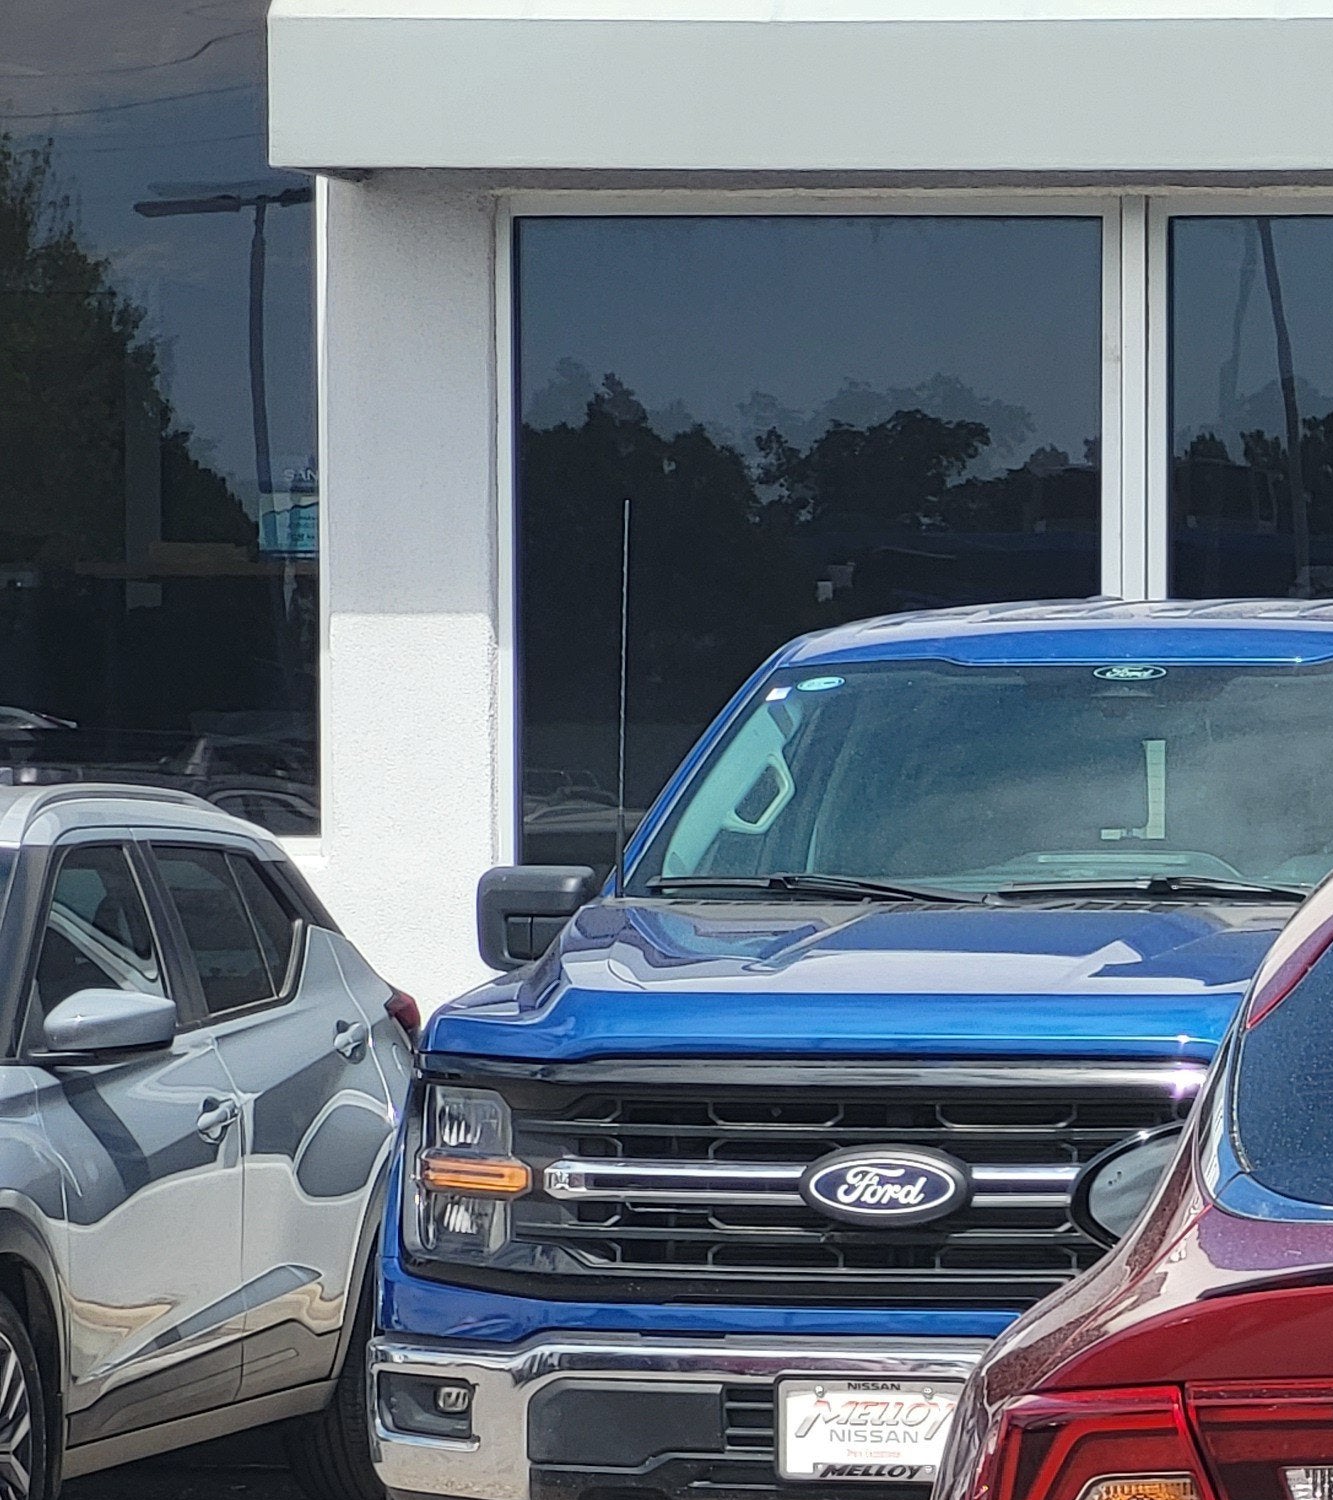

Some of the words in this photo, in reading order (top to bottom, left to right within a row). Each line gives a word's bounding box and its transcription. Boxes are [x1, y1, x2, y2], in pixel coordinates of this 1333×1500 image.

[836, 1166, 929, 1205] Ford
[847, 1382, 901, 1391] NISSAN
[794, 1399, 958, 1441] MELLOY
[830, 1429, 918, 1443] NISSAN
[819, 1464, 922, 1479] MELLOY
